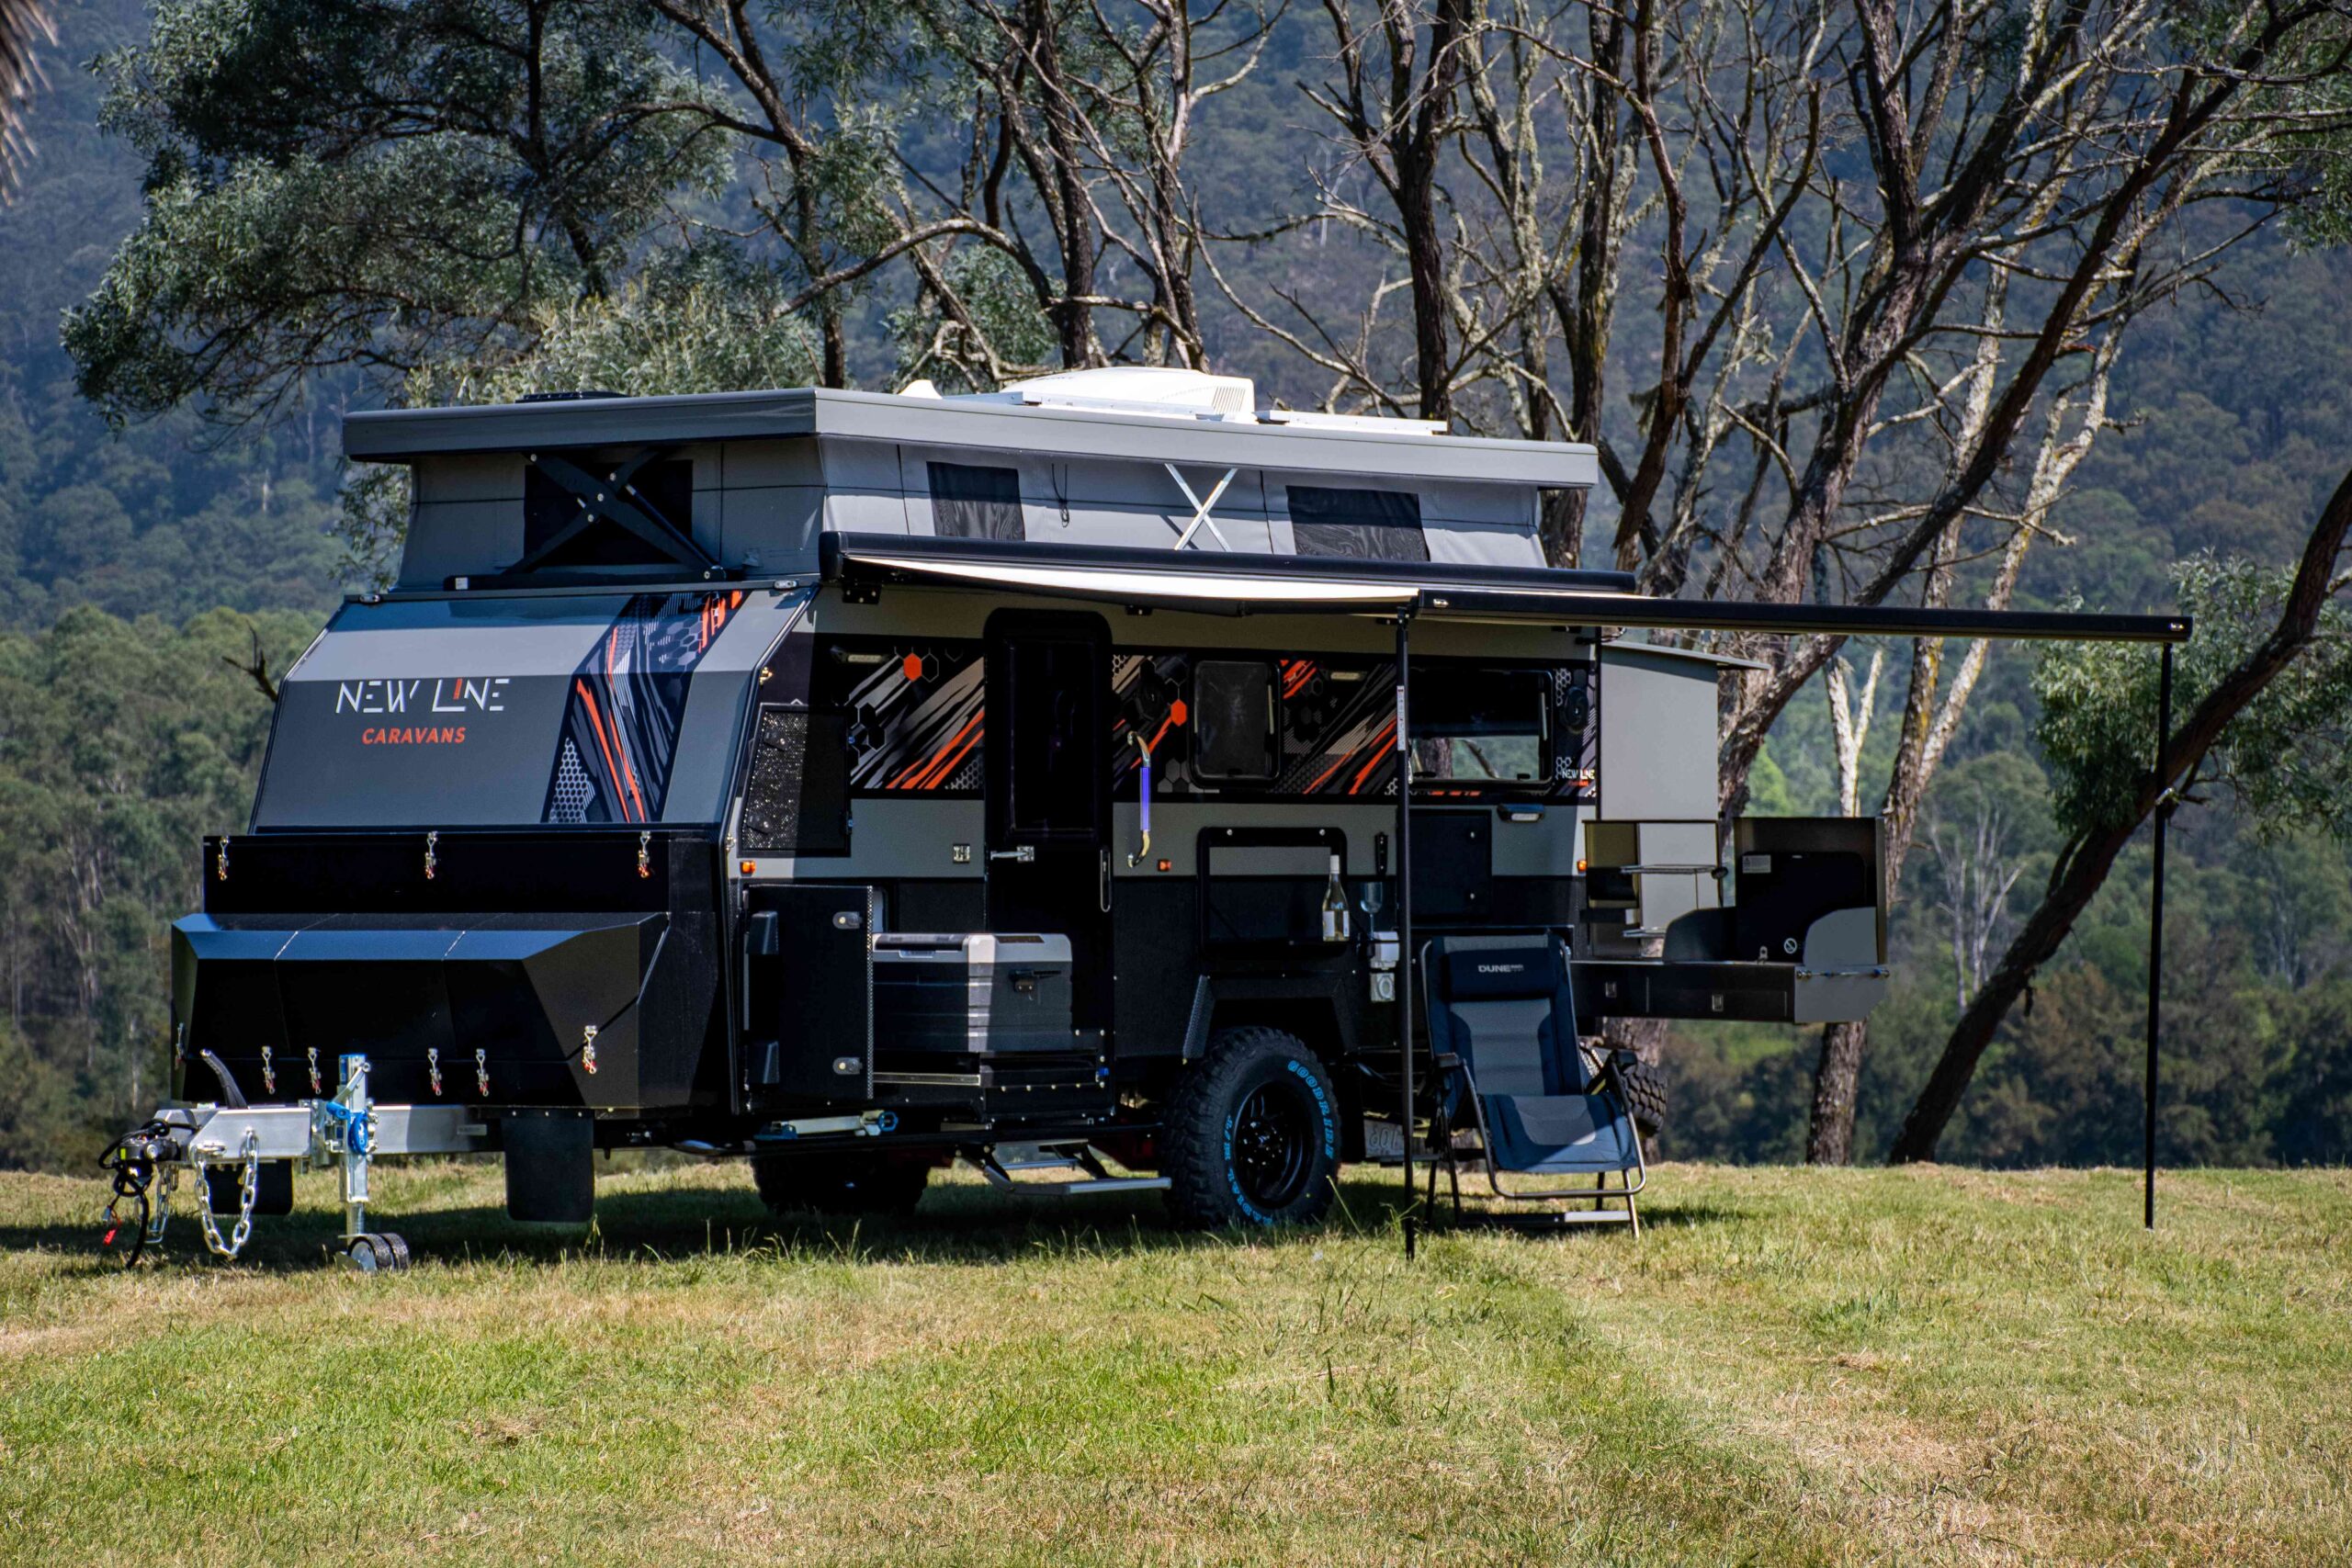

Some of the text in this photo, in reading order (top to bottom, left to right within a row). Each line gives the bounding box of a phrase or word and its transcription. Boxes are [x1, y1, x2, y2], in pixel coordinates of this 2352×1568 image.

[335, 678, 511, 714] NEW LINE
[361, 727, 466, 744] CARAVANS
[1561, 769, 1578, 779] NEW
[1477, 964, 1511, 973] DUNE
[1287, 1060, 1334, 1159] GOODRIDE
